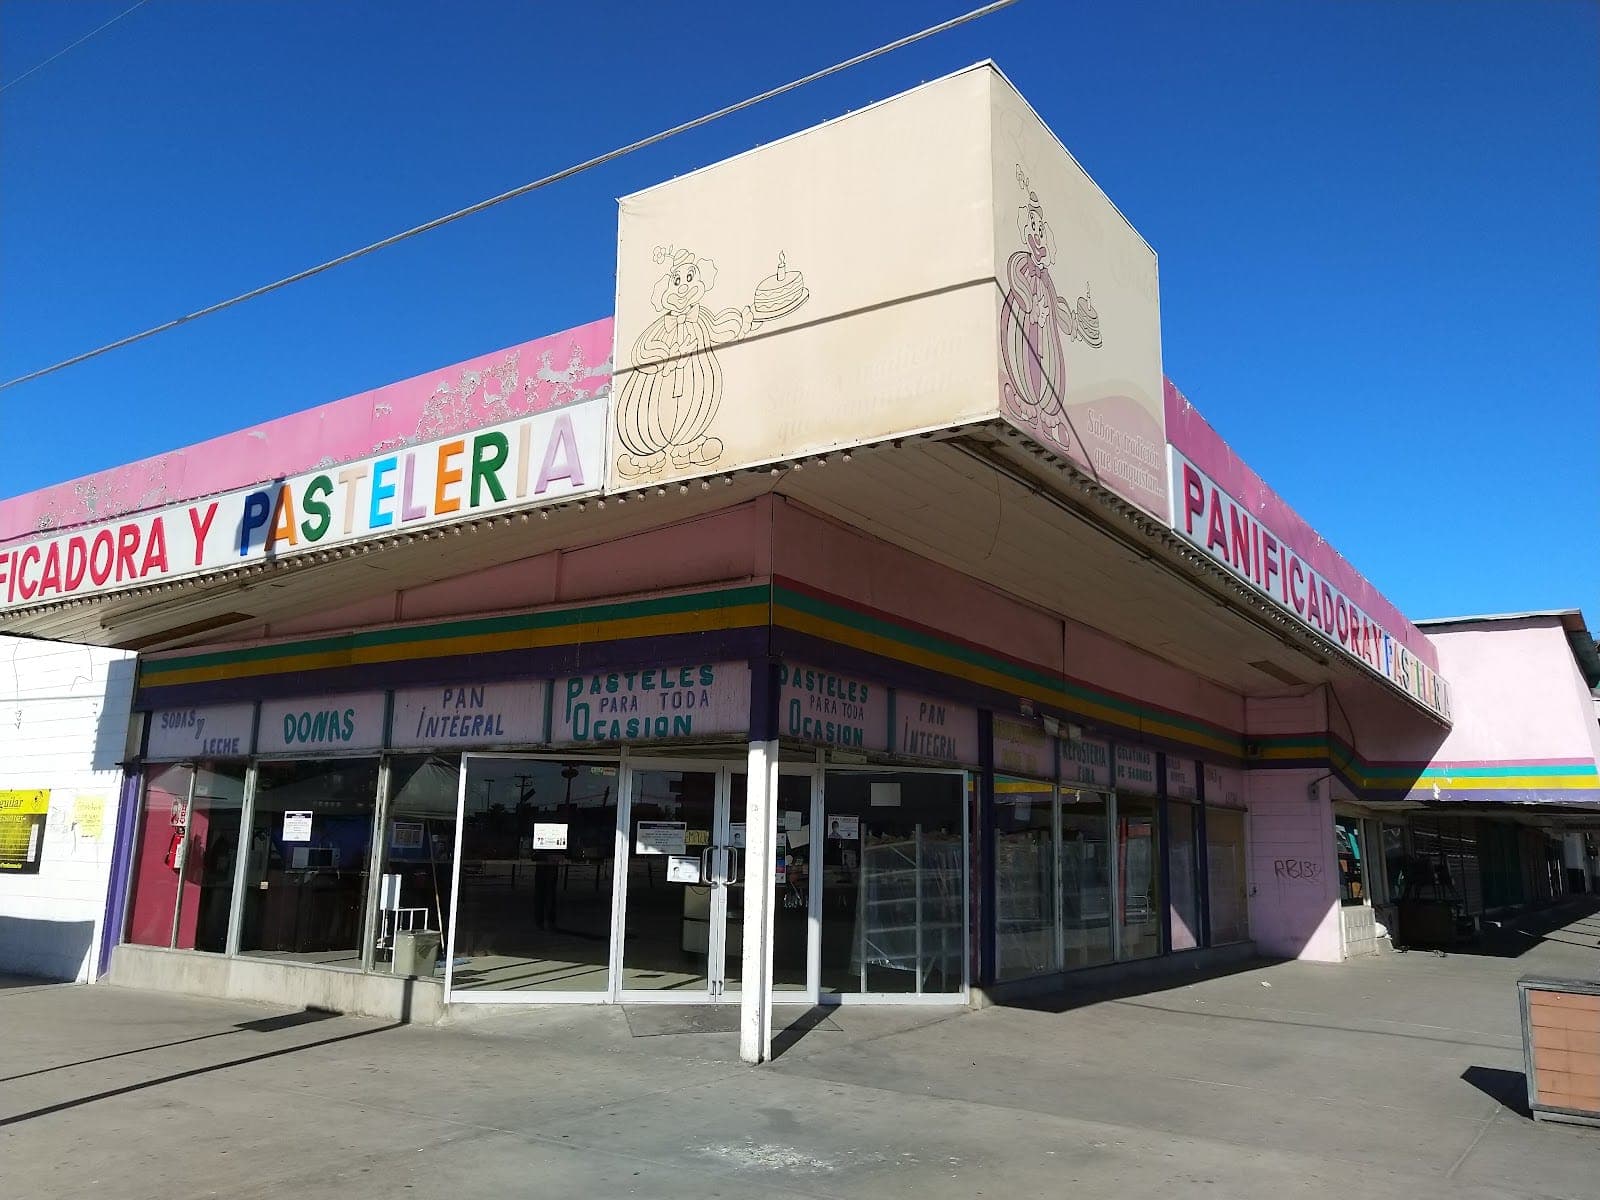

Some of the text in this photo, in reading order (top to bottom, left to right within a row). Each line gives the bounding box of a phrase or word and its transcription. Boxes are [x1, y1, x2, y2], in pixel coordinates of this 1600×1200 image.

[1087, 408, 1113, 445] Sabor
[1094, 447, 1111, 473] que
[188, 501, 219, 566] Y
[240, 413, 585, 556] PASTELERIA
[1183, 463, 1373, 665] PANIFICADORA
[1372, 623, 1382, 672] Y
[443, 687, 485, 709] PAN
[566, 664, 714, 724] PASTELES
[600, 690, 710, 713] PARA TODA
[778, 664, 868, 704] PASTELES
[161, 709, 196, 729] SODAS
[572, 703, 692, 741] OCASION
[789, 698, 864, 746] OCASION
[810, 694, 864, 721] PARA TODA
[920, 702, 945, 725] PAN
[283, 708, 355, 744] DONAS
[202, 737, 240, 756] LECHE
